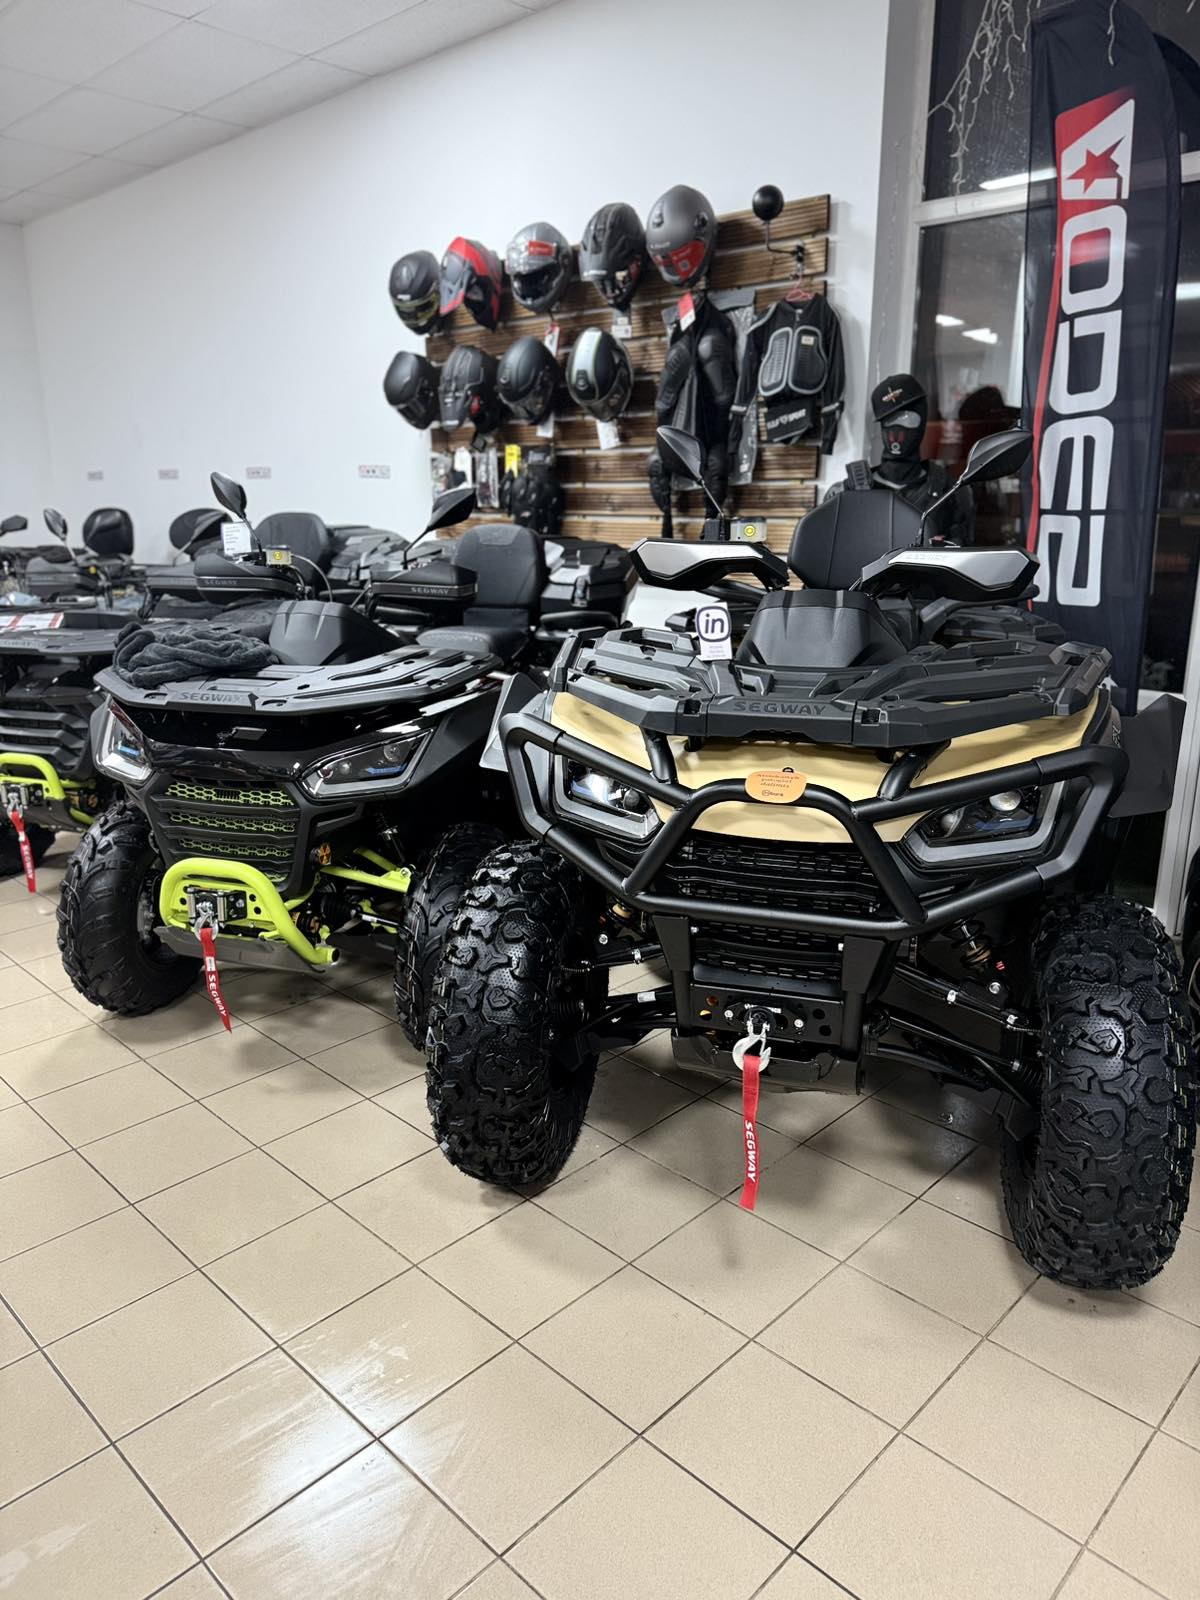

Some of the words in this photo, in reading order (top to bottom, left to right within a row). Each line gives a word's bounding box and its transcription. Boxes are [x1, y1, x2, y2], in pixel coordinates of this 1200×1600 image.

[410, 587, 449, 595] SEGWAY
[705, 613, 725, 634] in
[179, 692, 240, 703] SEGWAY
[732, 701, 826, 715] SEGWAY
[22, 844, 34, 880] SEGWAY
[209, 974, 227, 1017] SEGWAY
[744, 1119, 757, 1183] SEGWAY
